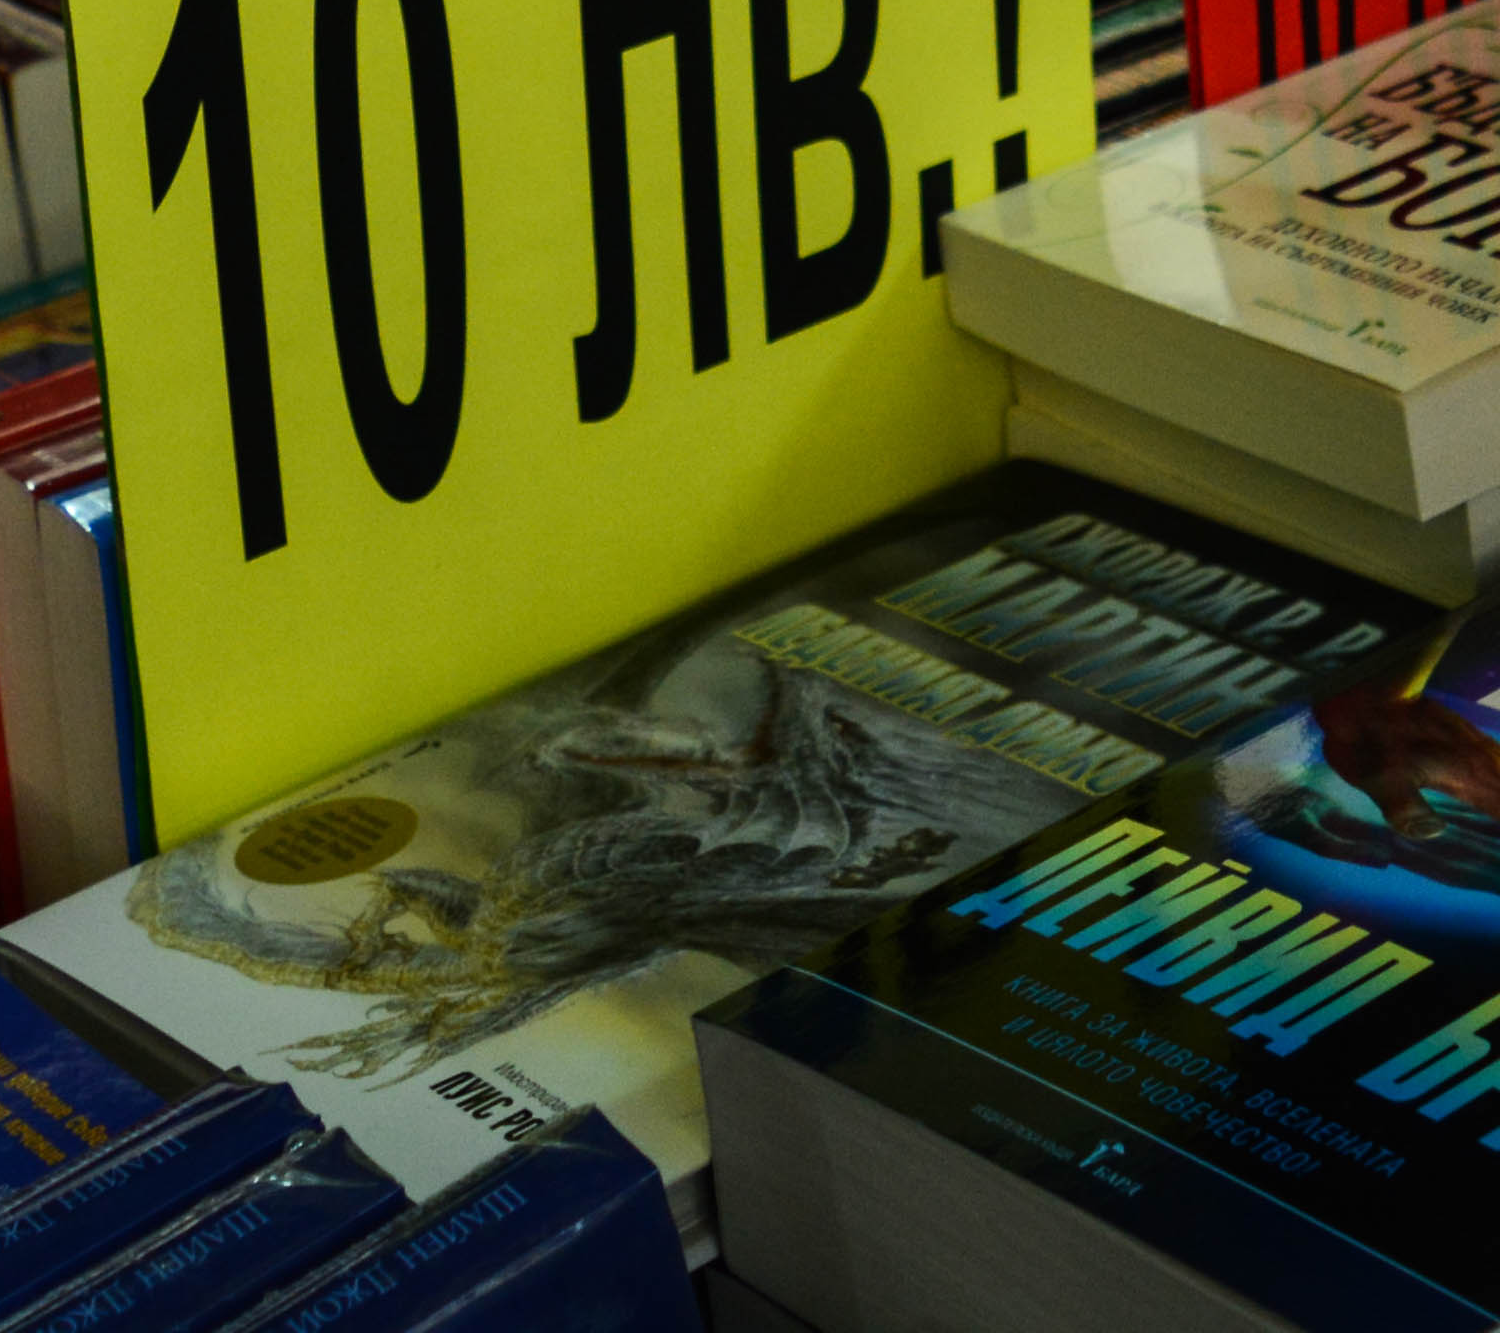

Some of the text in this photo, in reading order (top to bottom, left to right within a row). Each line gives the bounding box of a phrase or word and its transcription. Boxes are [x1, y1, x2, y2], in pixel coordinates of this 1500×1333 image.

[874, 544, 1303, 740] МАРТИН
[946, 700, 1167, 797] ДРАКО
[946, 816, 1435, 1061] ДЕЙВИД
[430, 1071, 546, 1143] ЛУИС РО
[1001, 1011, 1030, 1039] И
[1028, 1025, 1134, 1086] ЦЯЛОТО
[1136, 1075, 1325, 1180] ЧОВЕЧЕСТВО!
[1002, 971, 1090, 1027] КНИГА
[1092, 1011, 1131, 1044] ЗА
[1239, 1084, 1407, 1180] ВСЕЛЕНАТА
[40, 1276, 131, 1333] ДЖО
